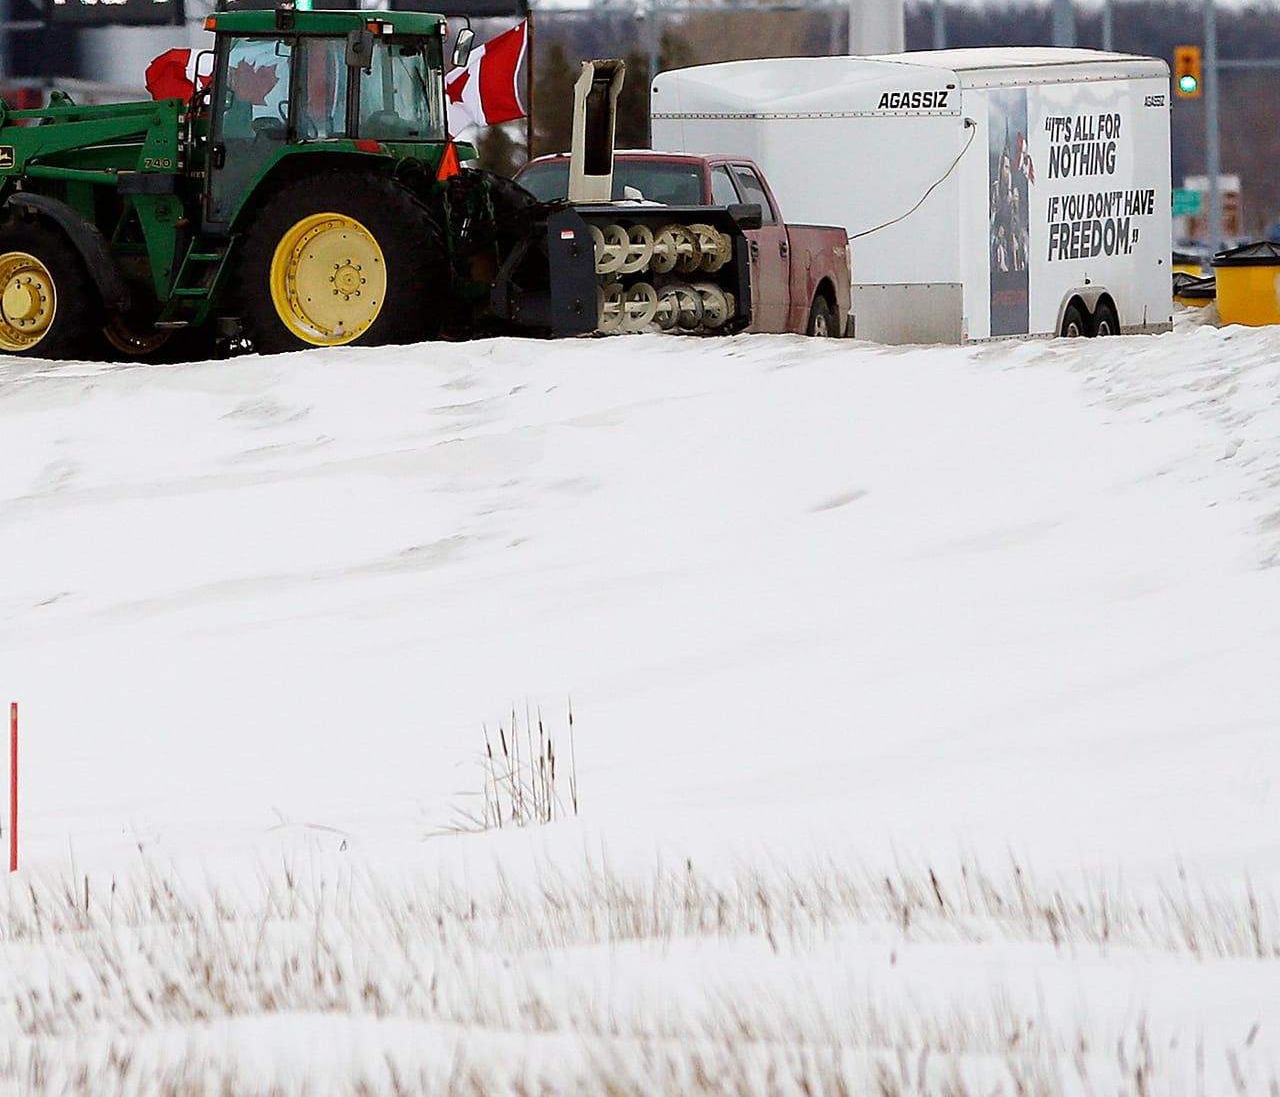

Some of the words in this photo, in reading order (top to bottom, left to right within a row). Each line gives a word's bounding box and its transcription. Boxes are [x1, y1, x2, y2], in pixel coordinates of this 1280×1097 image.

[877, 91, 948, 109] AGASSIZ
[1045, 116, 1072, 142] "IT'S
[1073, 115, 1095, 142] ALL
[1097, 113, 1120, 140] FOR
[144, 157, 172, 169] 740
[1048, 141, 1116, 179] NOTHING
[1047, 197, 1059, 223] IF
[1061, 194, 1085, 221] YOU
[1087, 192, 1123, 219] DON'T
[1124, 189, 1155, 216] HAVE
[1047, 217, 1140, 262] FREEDOM."
